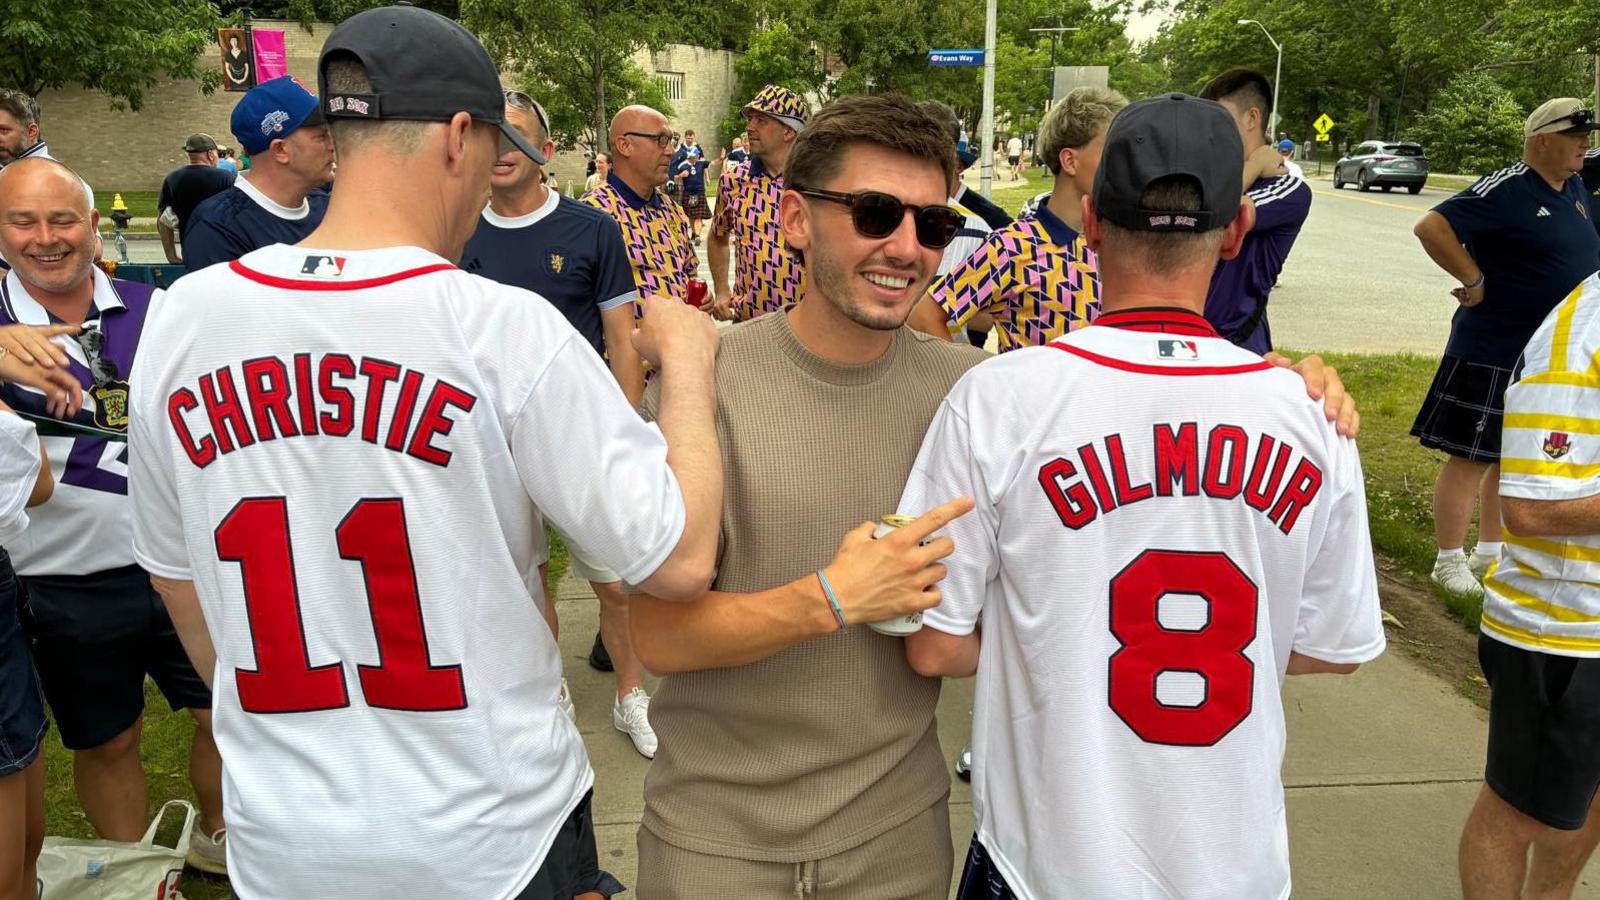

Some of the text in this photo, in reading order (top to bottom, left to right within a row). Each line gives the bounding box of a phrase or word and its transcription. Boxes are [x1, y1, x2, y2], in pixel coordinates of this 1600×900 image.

[959, 54, 974, 63] Way
[168, 352, 477, 469] CHRISTIE
[1038, 422, 1322, 536] GILMOUR
[214, 495, 469, 714] 11
[1108, 548, 1259, 747] 8
